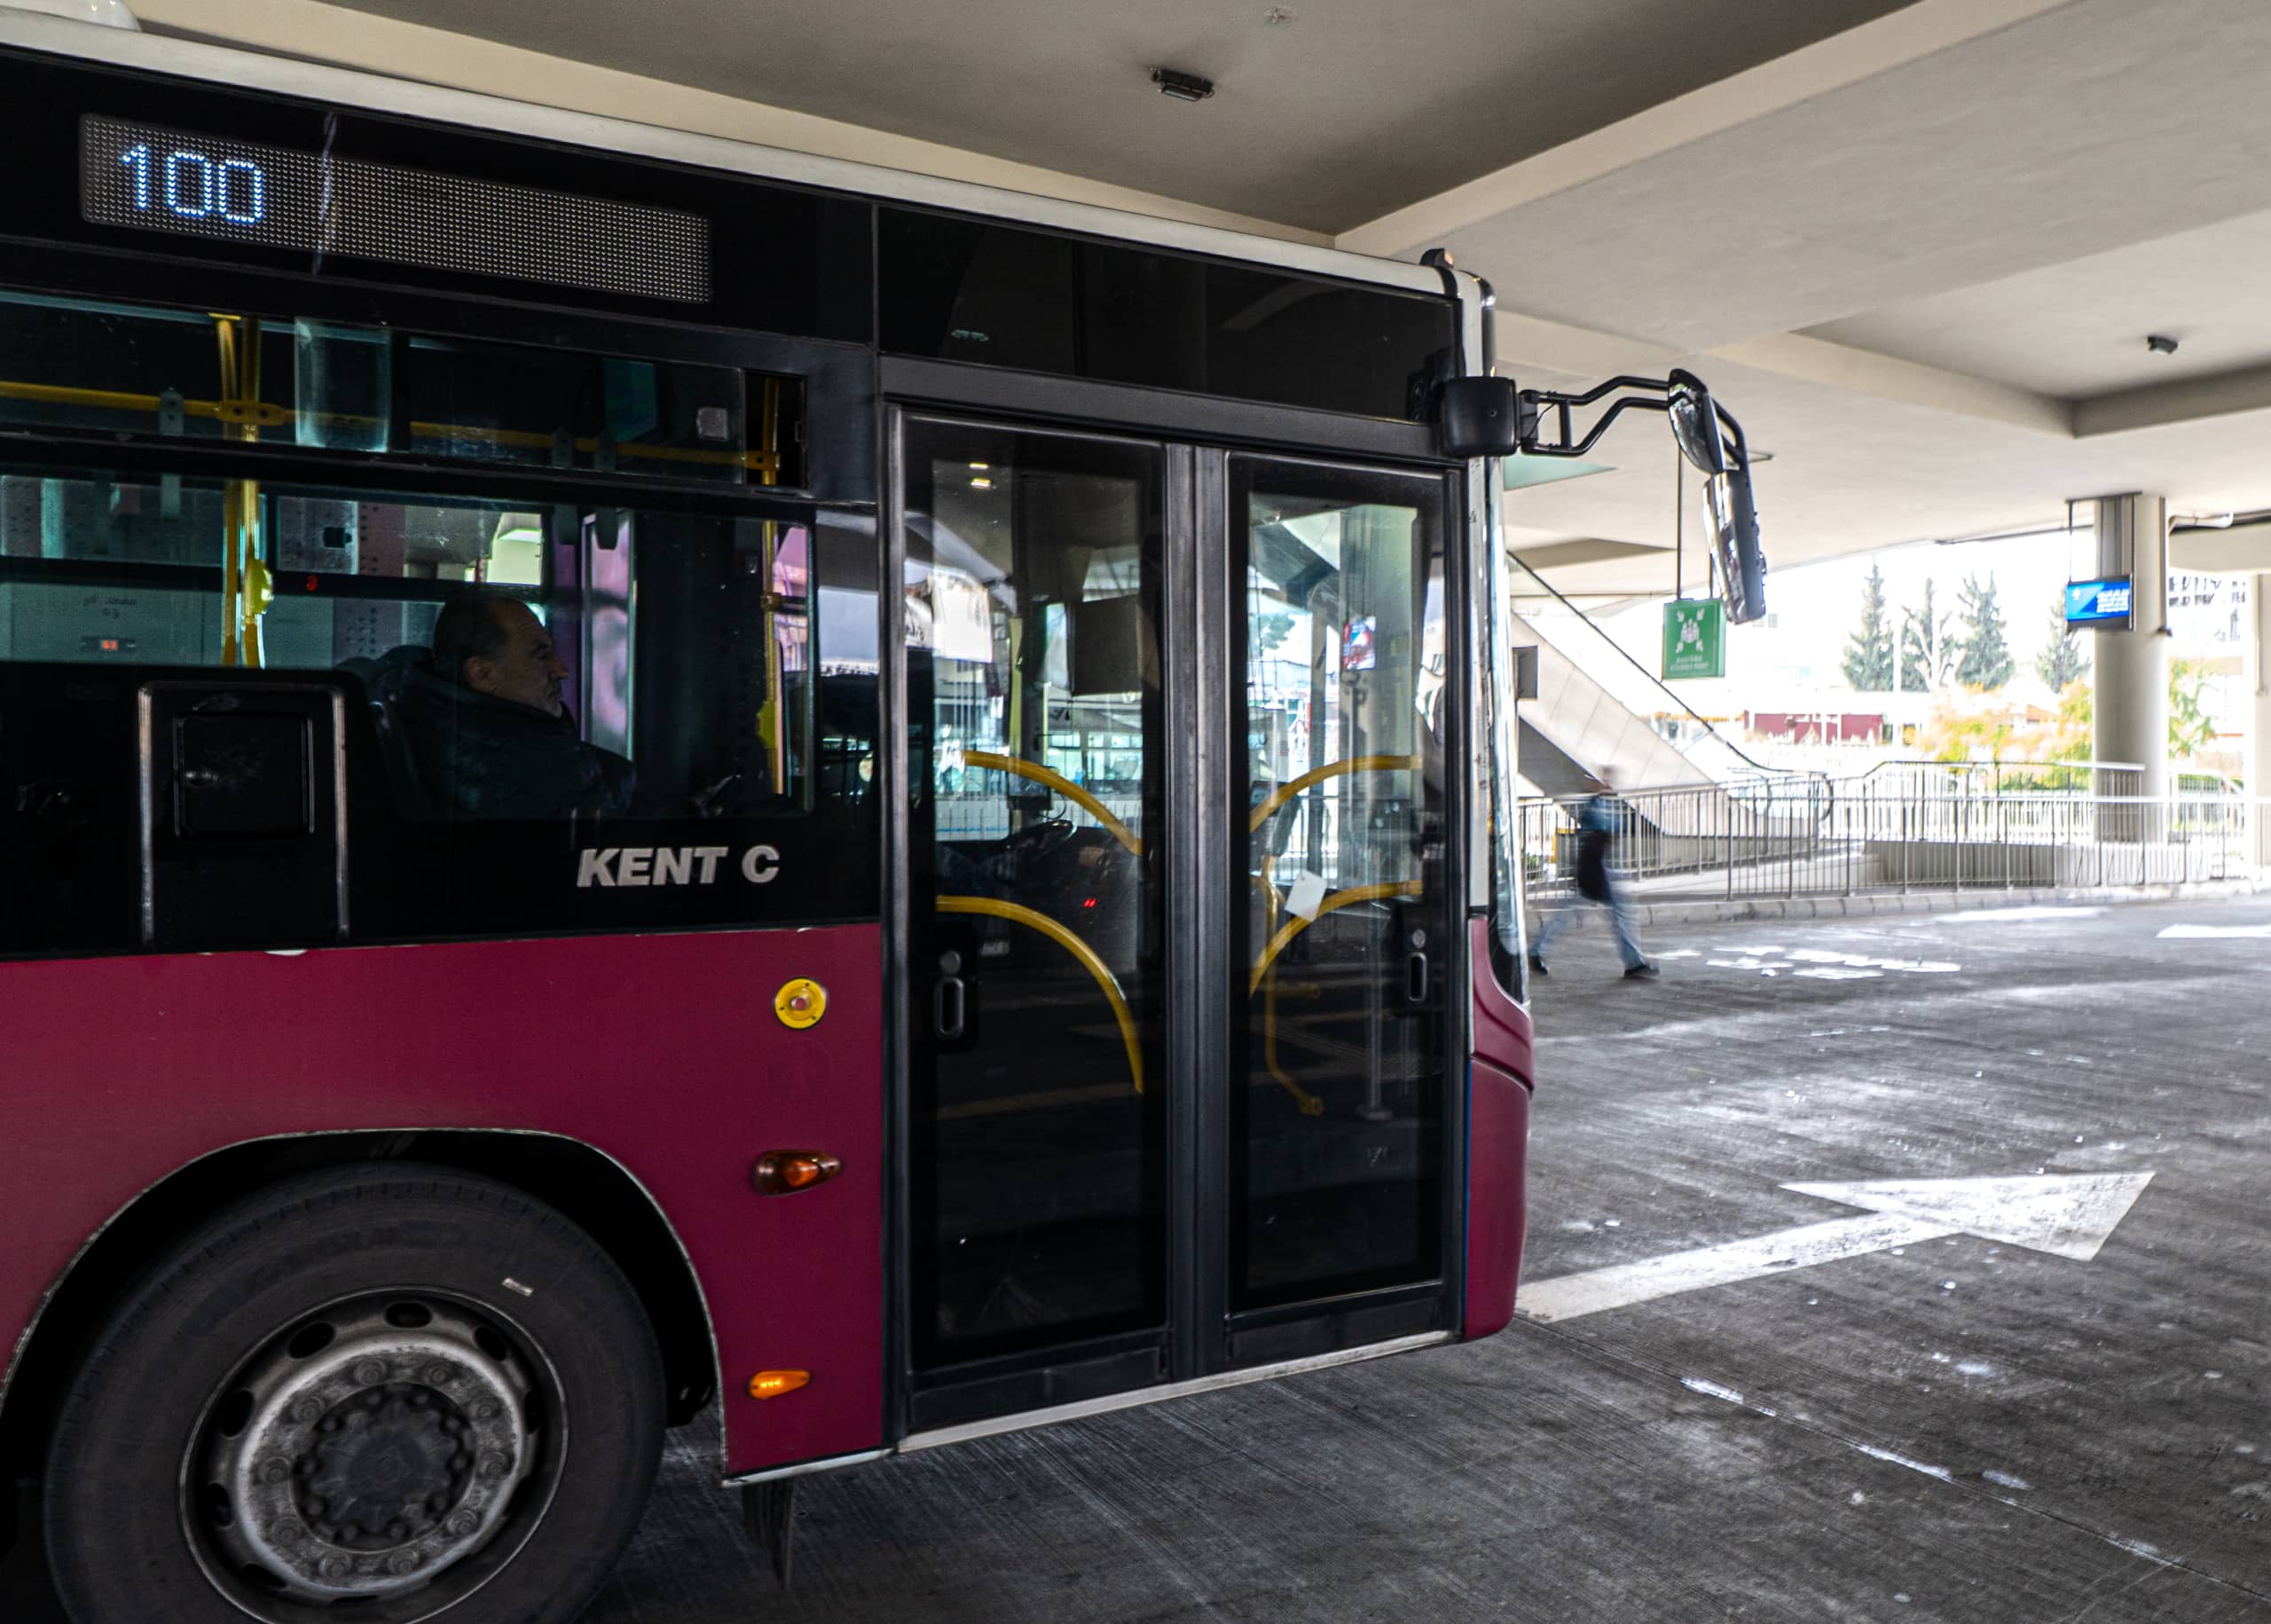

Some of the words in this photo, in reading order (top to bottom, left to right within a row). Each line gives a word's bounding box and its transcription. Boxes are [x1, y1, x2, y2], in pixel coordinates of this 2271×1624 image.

[122, 144, 263, 224] 100
[577, 846, 729, 888] KENT
[742, 844, 780, 883] C
